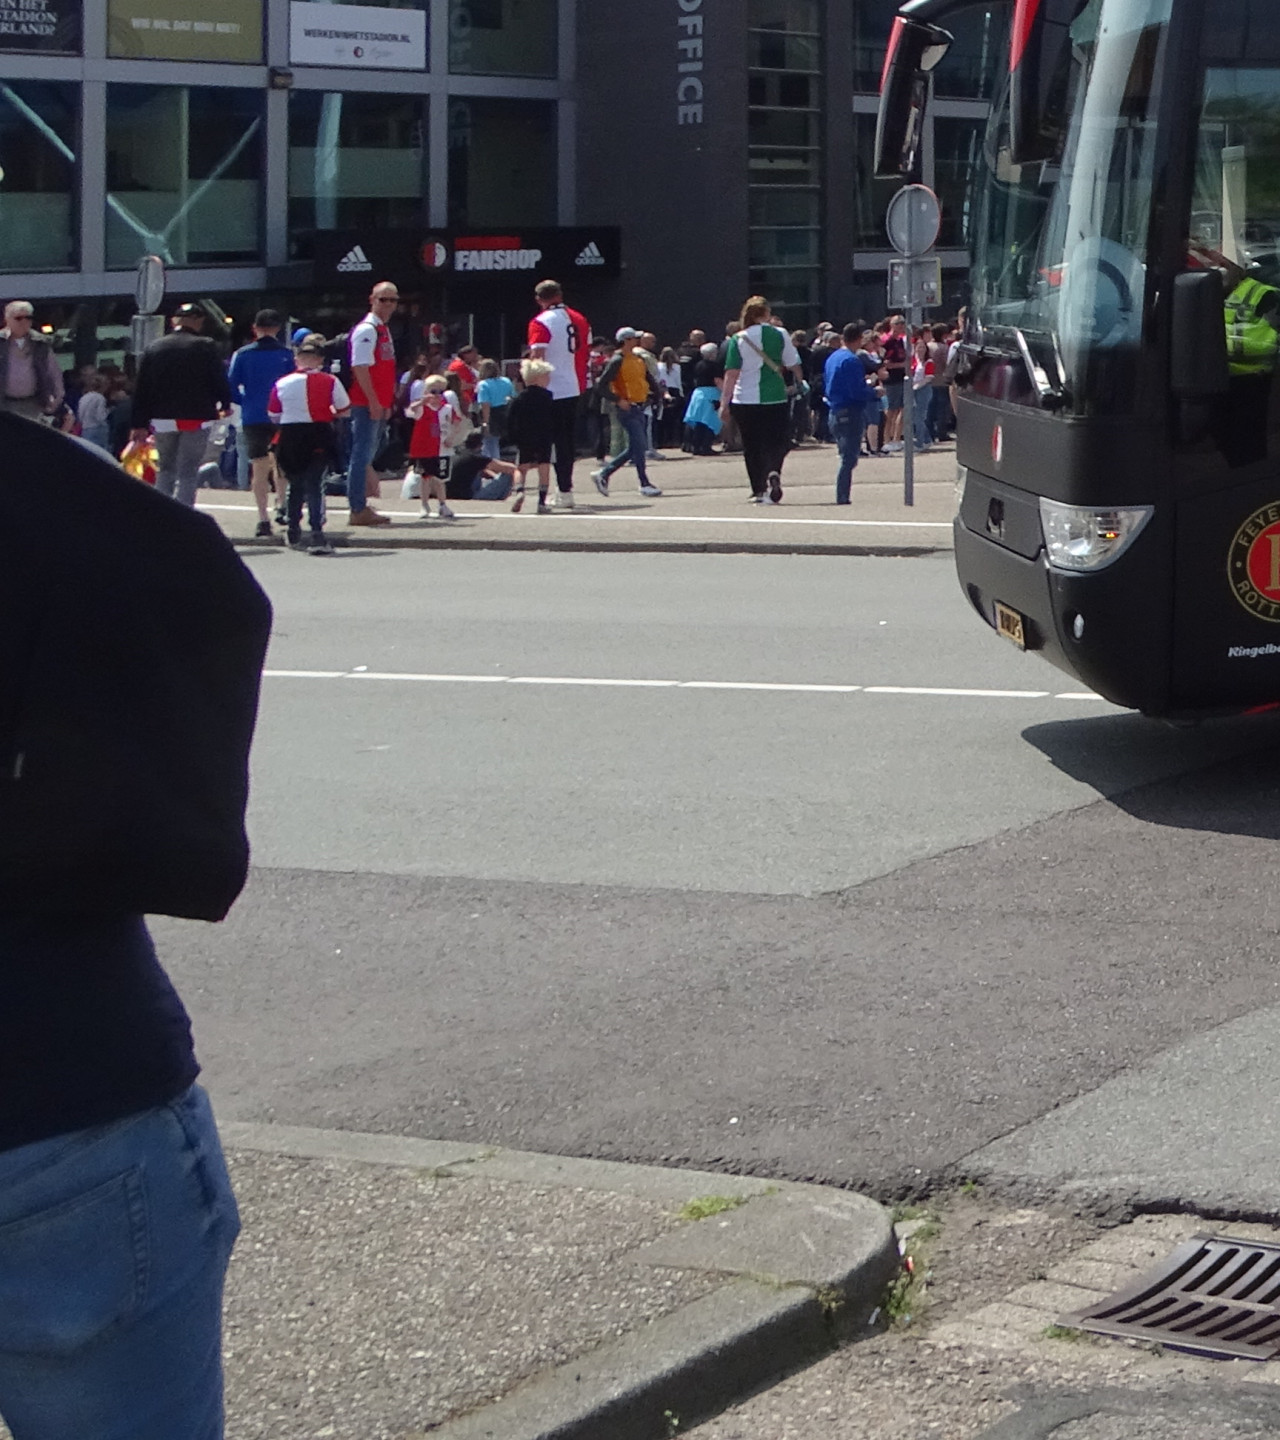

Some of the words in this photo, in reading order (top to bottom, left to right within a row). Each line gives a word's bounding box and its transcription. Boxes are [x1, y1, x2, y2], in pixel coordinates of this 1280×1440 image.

[0, 10, 57, 23] TADION
[453, 248, 542, 271] FANSHOP
[574, 256, 606, 266] adidas
[336, 262, 373, 272] adidas
